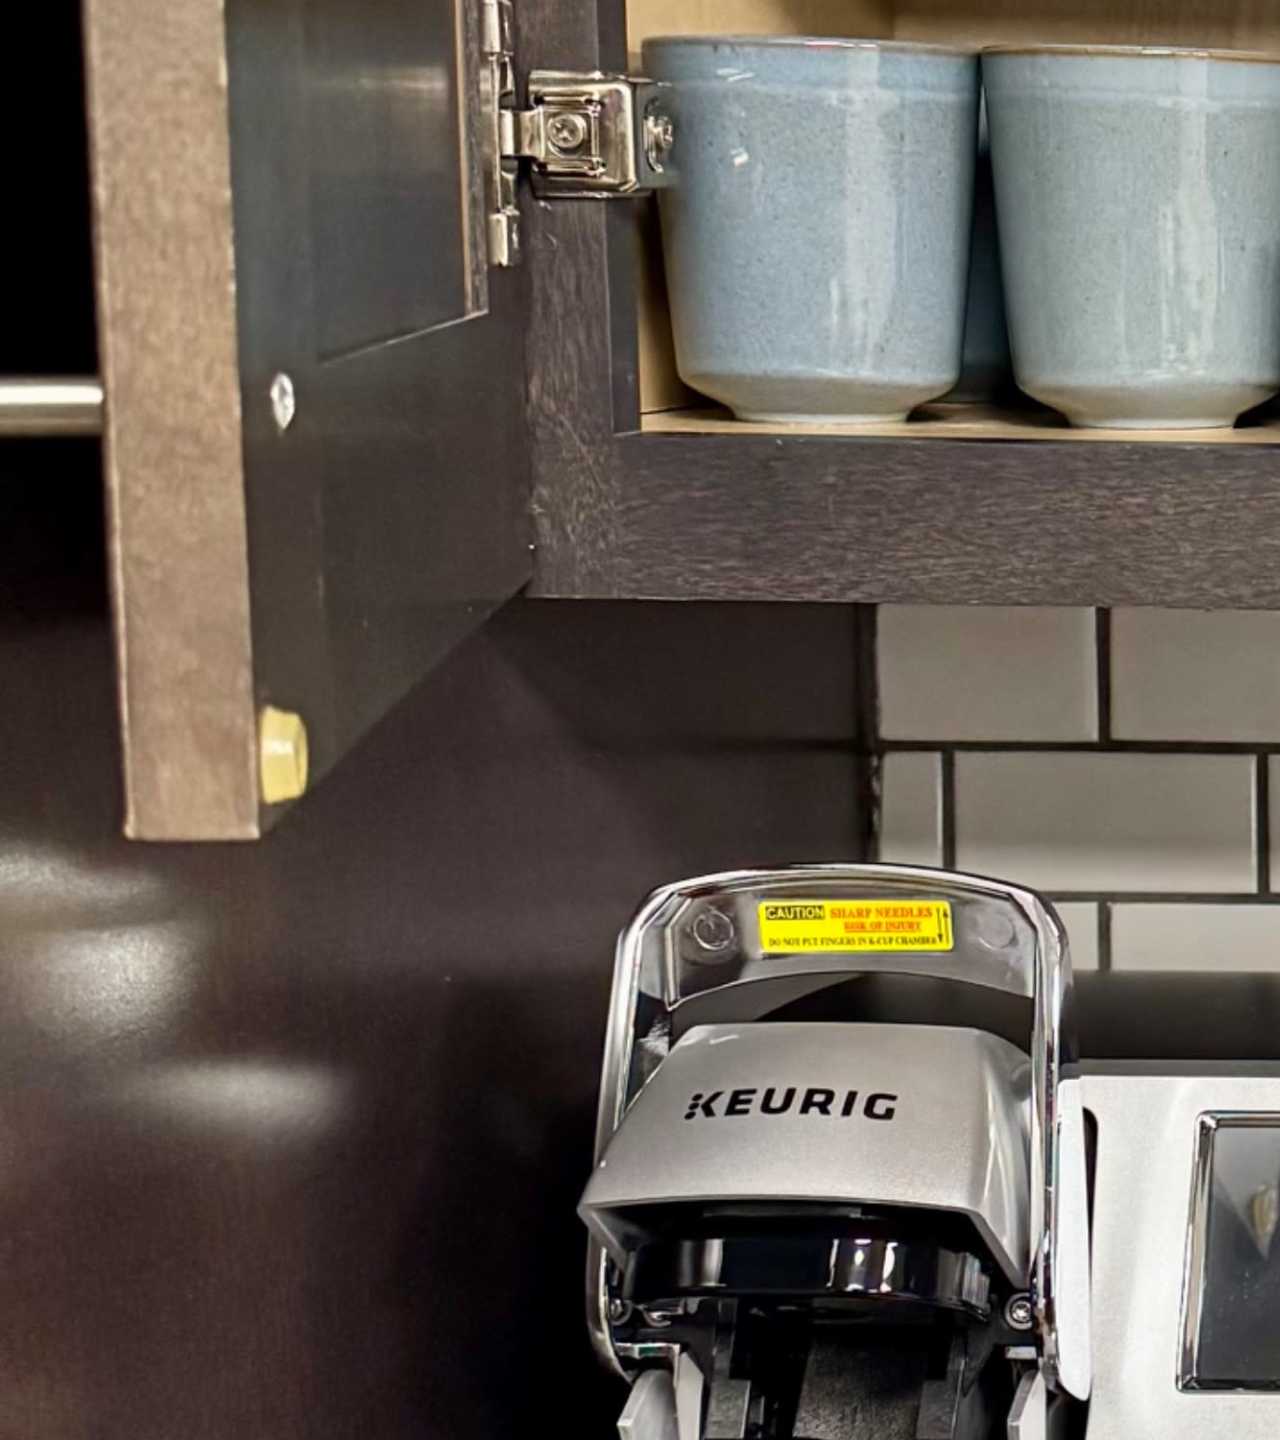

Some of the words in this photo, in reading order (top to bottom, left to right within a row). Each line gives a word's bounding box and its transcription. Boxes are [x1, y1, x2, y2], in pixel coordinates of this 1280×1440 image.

[766, 906, 825, 920] CAUTION
[831, 907, 870, 918] SHARP
[876, 906, 933, 918] NEEDLES
[783, 937, 800, 946] NOT
[821, 936, 855, 946] FINGERS
[684, 1088, 898, 1120] KEURIG
